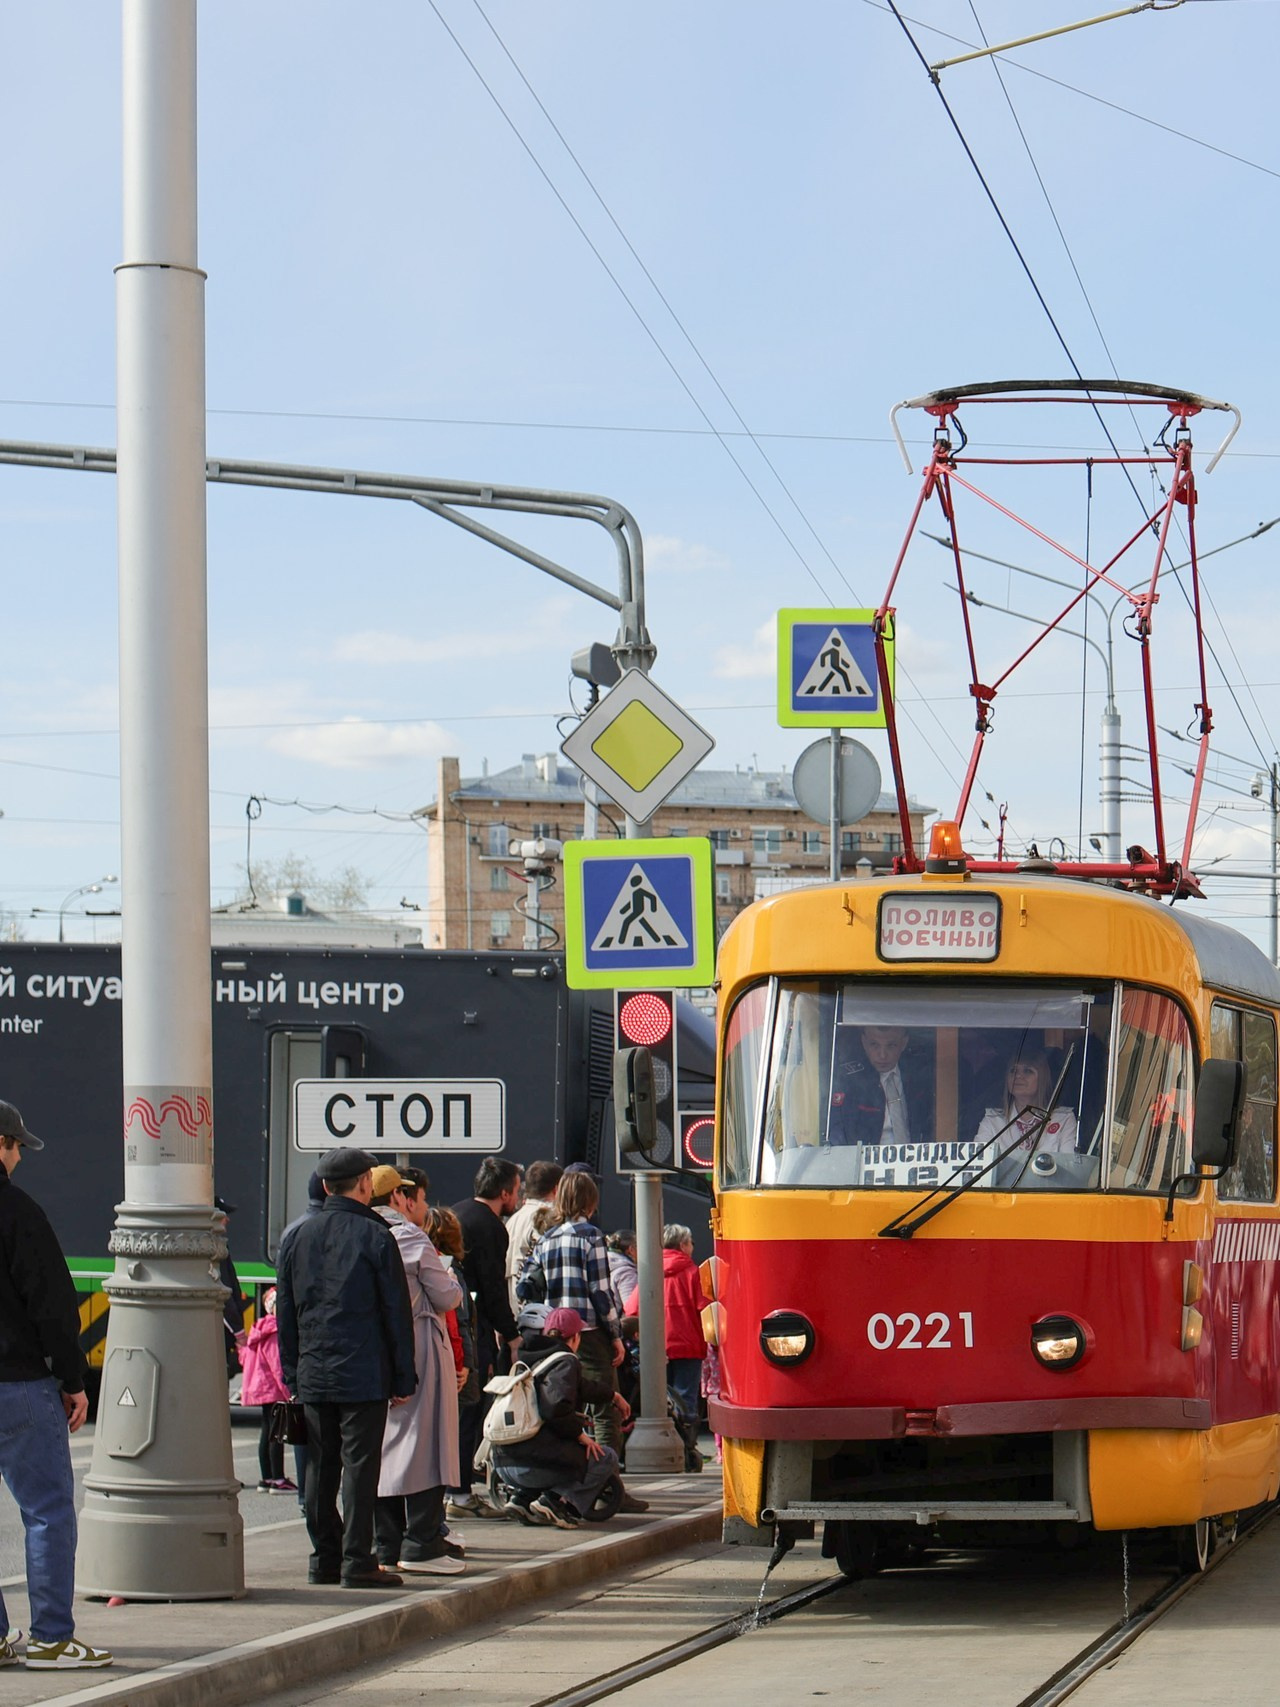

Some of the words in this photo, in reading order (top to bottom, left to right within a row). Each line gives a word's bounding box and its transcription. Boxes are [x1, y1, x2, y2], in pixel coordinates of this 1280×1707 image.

[887, 907, 996, 927] ПОЛИВО
[298, 981, 405, 1013] центр
[325, 1093, 472, 1138] СТОП
[864, 1143, 985, 1165] ПОСАДКИ
[867, 1312, 974, 1350] 0221
